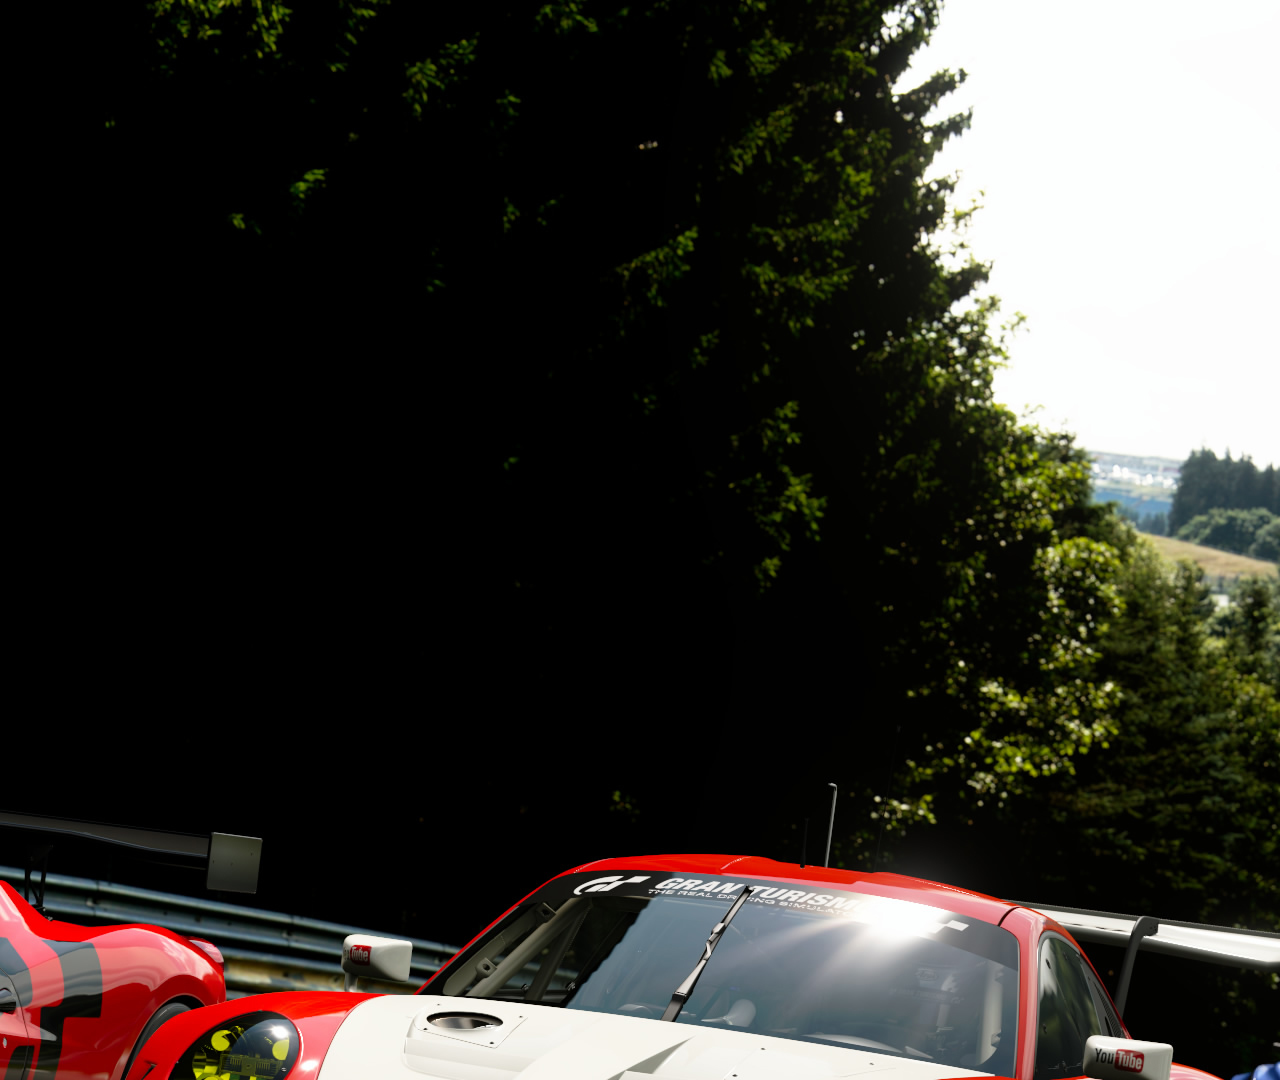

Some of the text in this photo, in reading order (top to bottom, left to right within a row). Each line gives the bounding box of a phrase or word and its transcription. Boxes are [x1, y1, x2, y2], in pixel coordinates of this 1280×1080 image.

[655, 877, 868, 912] GRAN TURISM
[677, 890, 713, 898] REAL
[1095, 1047, 1143, 1070] YouTube
